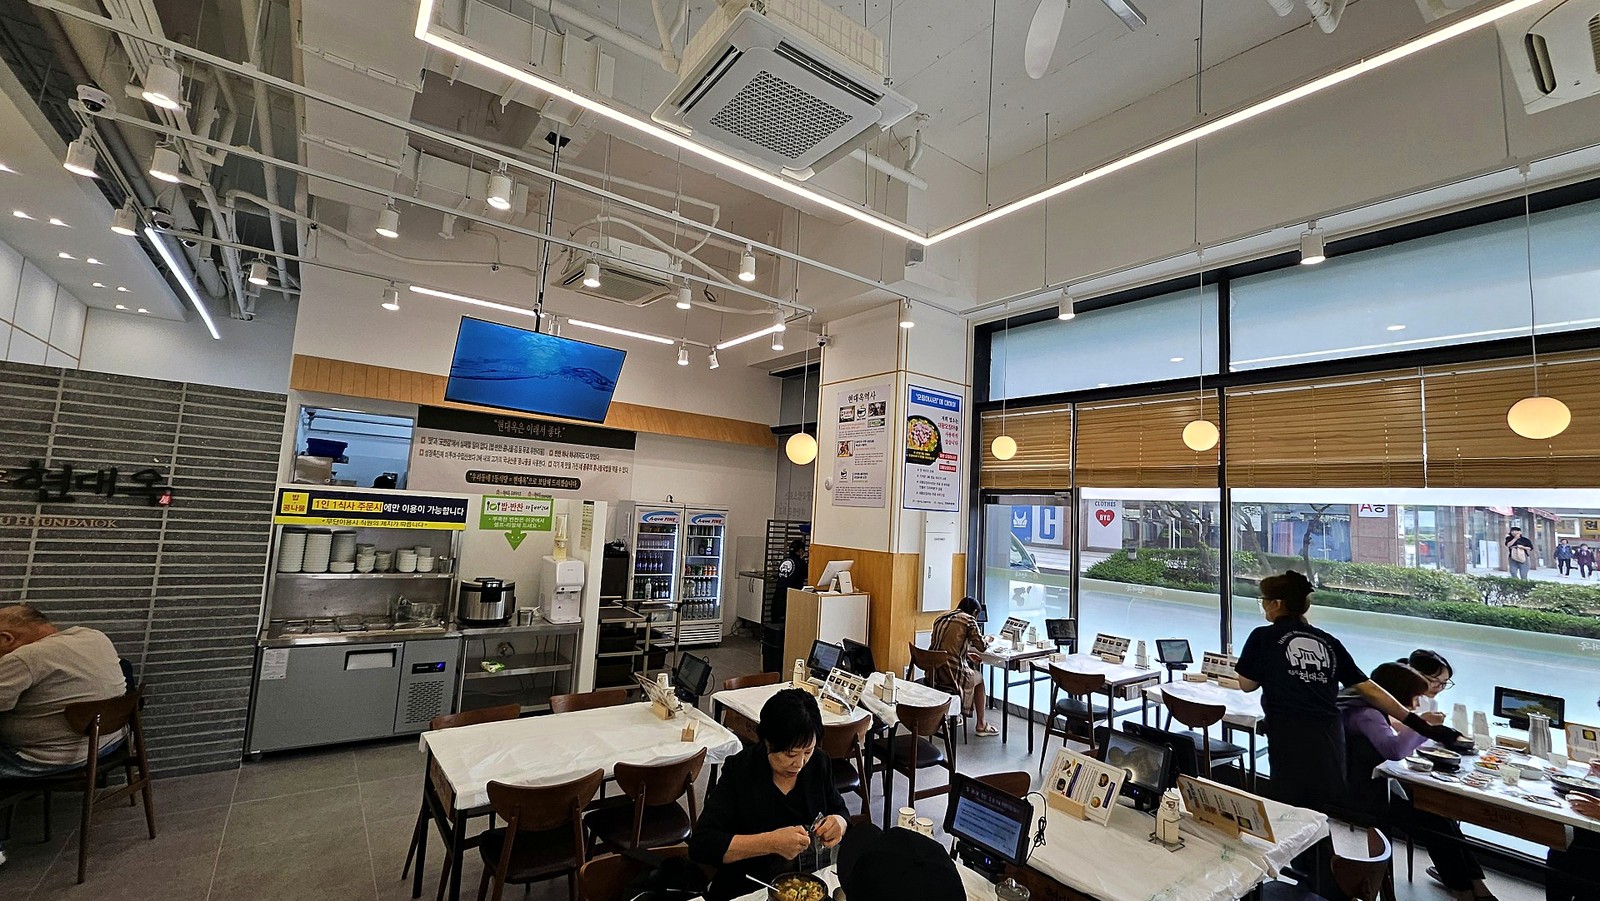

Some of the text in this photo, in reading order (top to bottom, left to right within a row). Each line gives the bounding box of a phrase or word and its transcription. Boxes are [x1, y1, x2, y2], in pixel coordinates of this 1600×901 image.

[847, 391, 877, 403] 현대옥역사
[526, 423, 546, 437] 이래서
[13, 459, 173, 506] 현대옥
[283, 504, 305, 512] 콩나물
[316, 500, 330, 509] 1인
[333, 501, 355, 511] 1식사
[402, 504, 425, 514] 이용이
[427, 506, 464, 516] 가능합니다
[15, 515, 118, 528] HYUNDAIOK
[1584, 519, 1599, 531] 원
